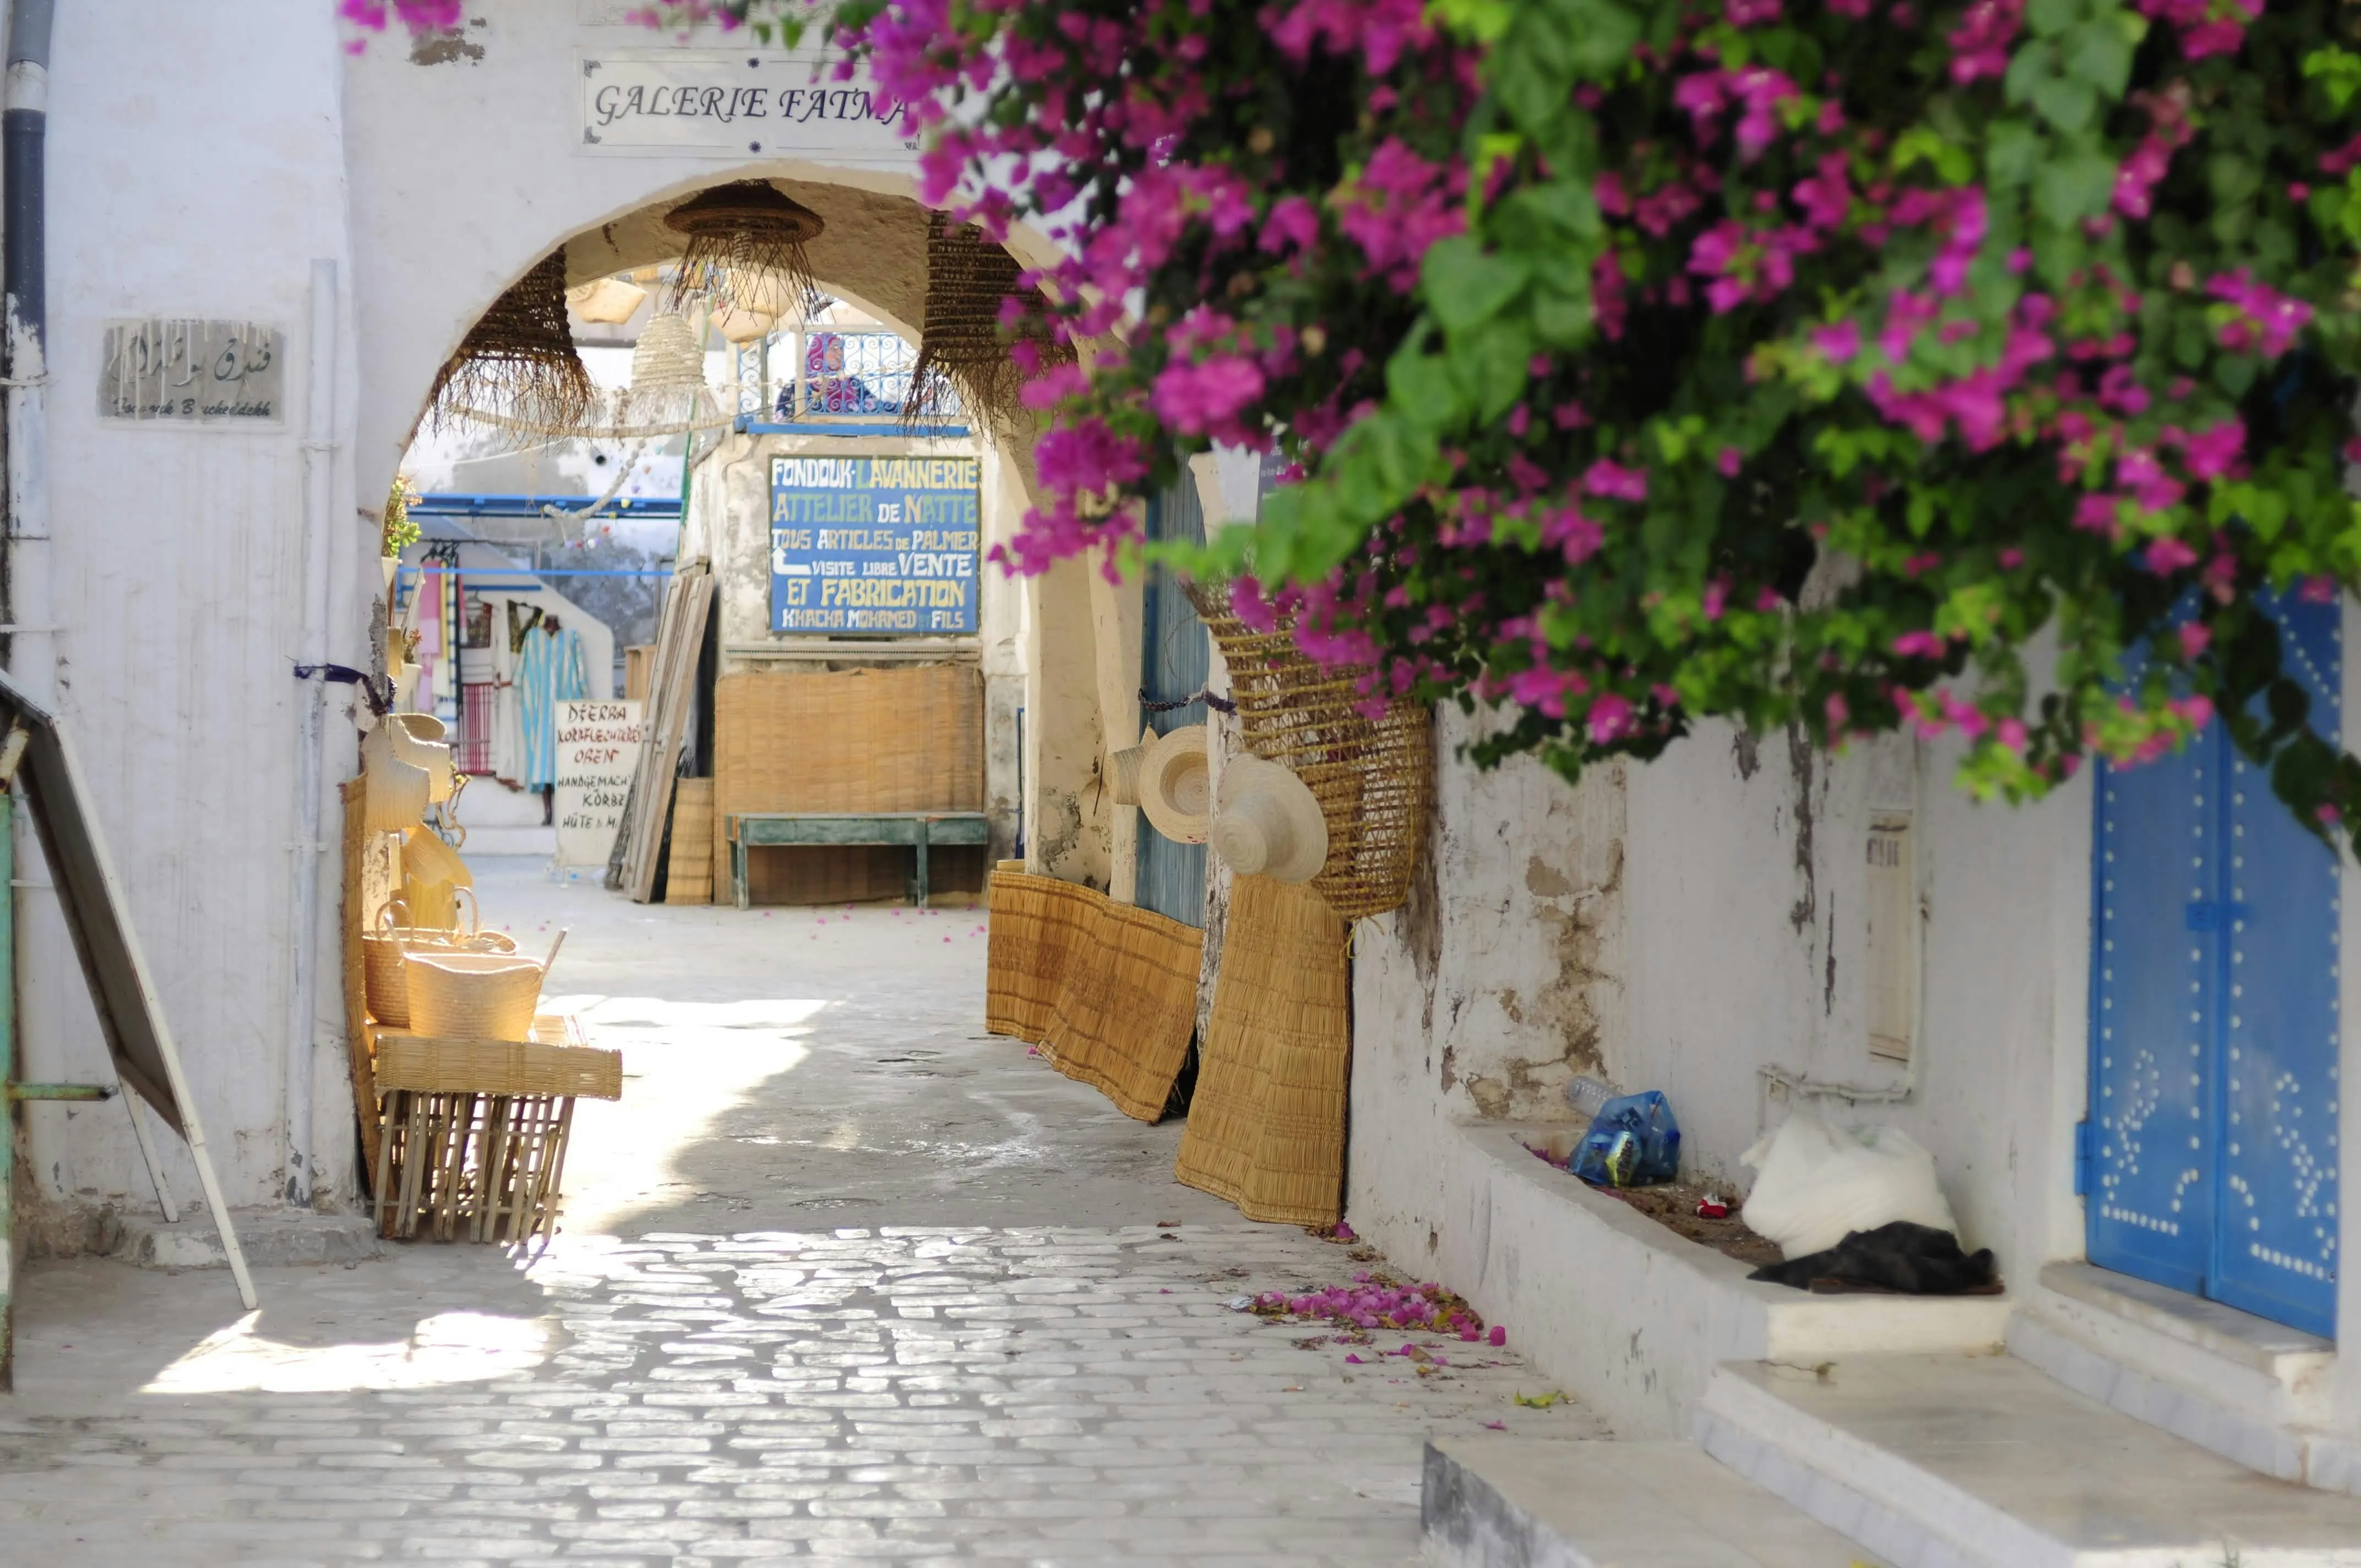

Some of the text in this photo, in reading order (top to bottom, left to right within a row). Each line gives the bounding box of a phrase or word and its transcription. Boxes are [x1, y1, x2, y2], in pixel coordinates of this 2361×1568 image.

[595, 85, 910, 126] GALERIE FATMA
[774, 492, 977, 524] ATTELIER DE NATTE
[771, 529, 977, 551] TOUS ARTICLES DE PALMIER
[812, 553, 972, 577] VISITE LIBRE VENTE
[787, 579, 966, 607] ET FABRICATION
[782, 609, 844, 628] KHACHA
[847, 609, 916, 628] MOHAMED
[931, 611, 964, 629] FILS
